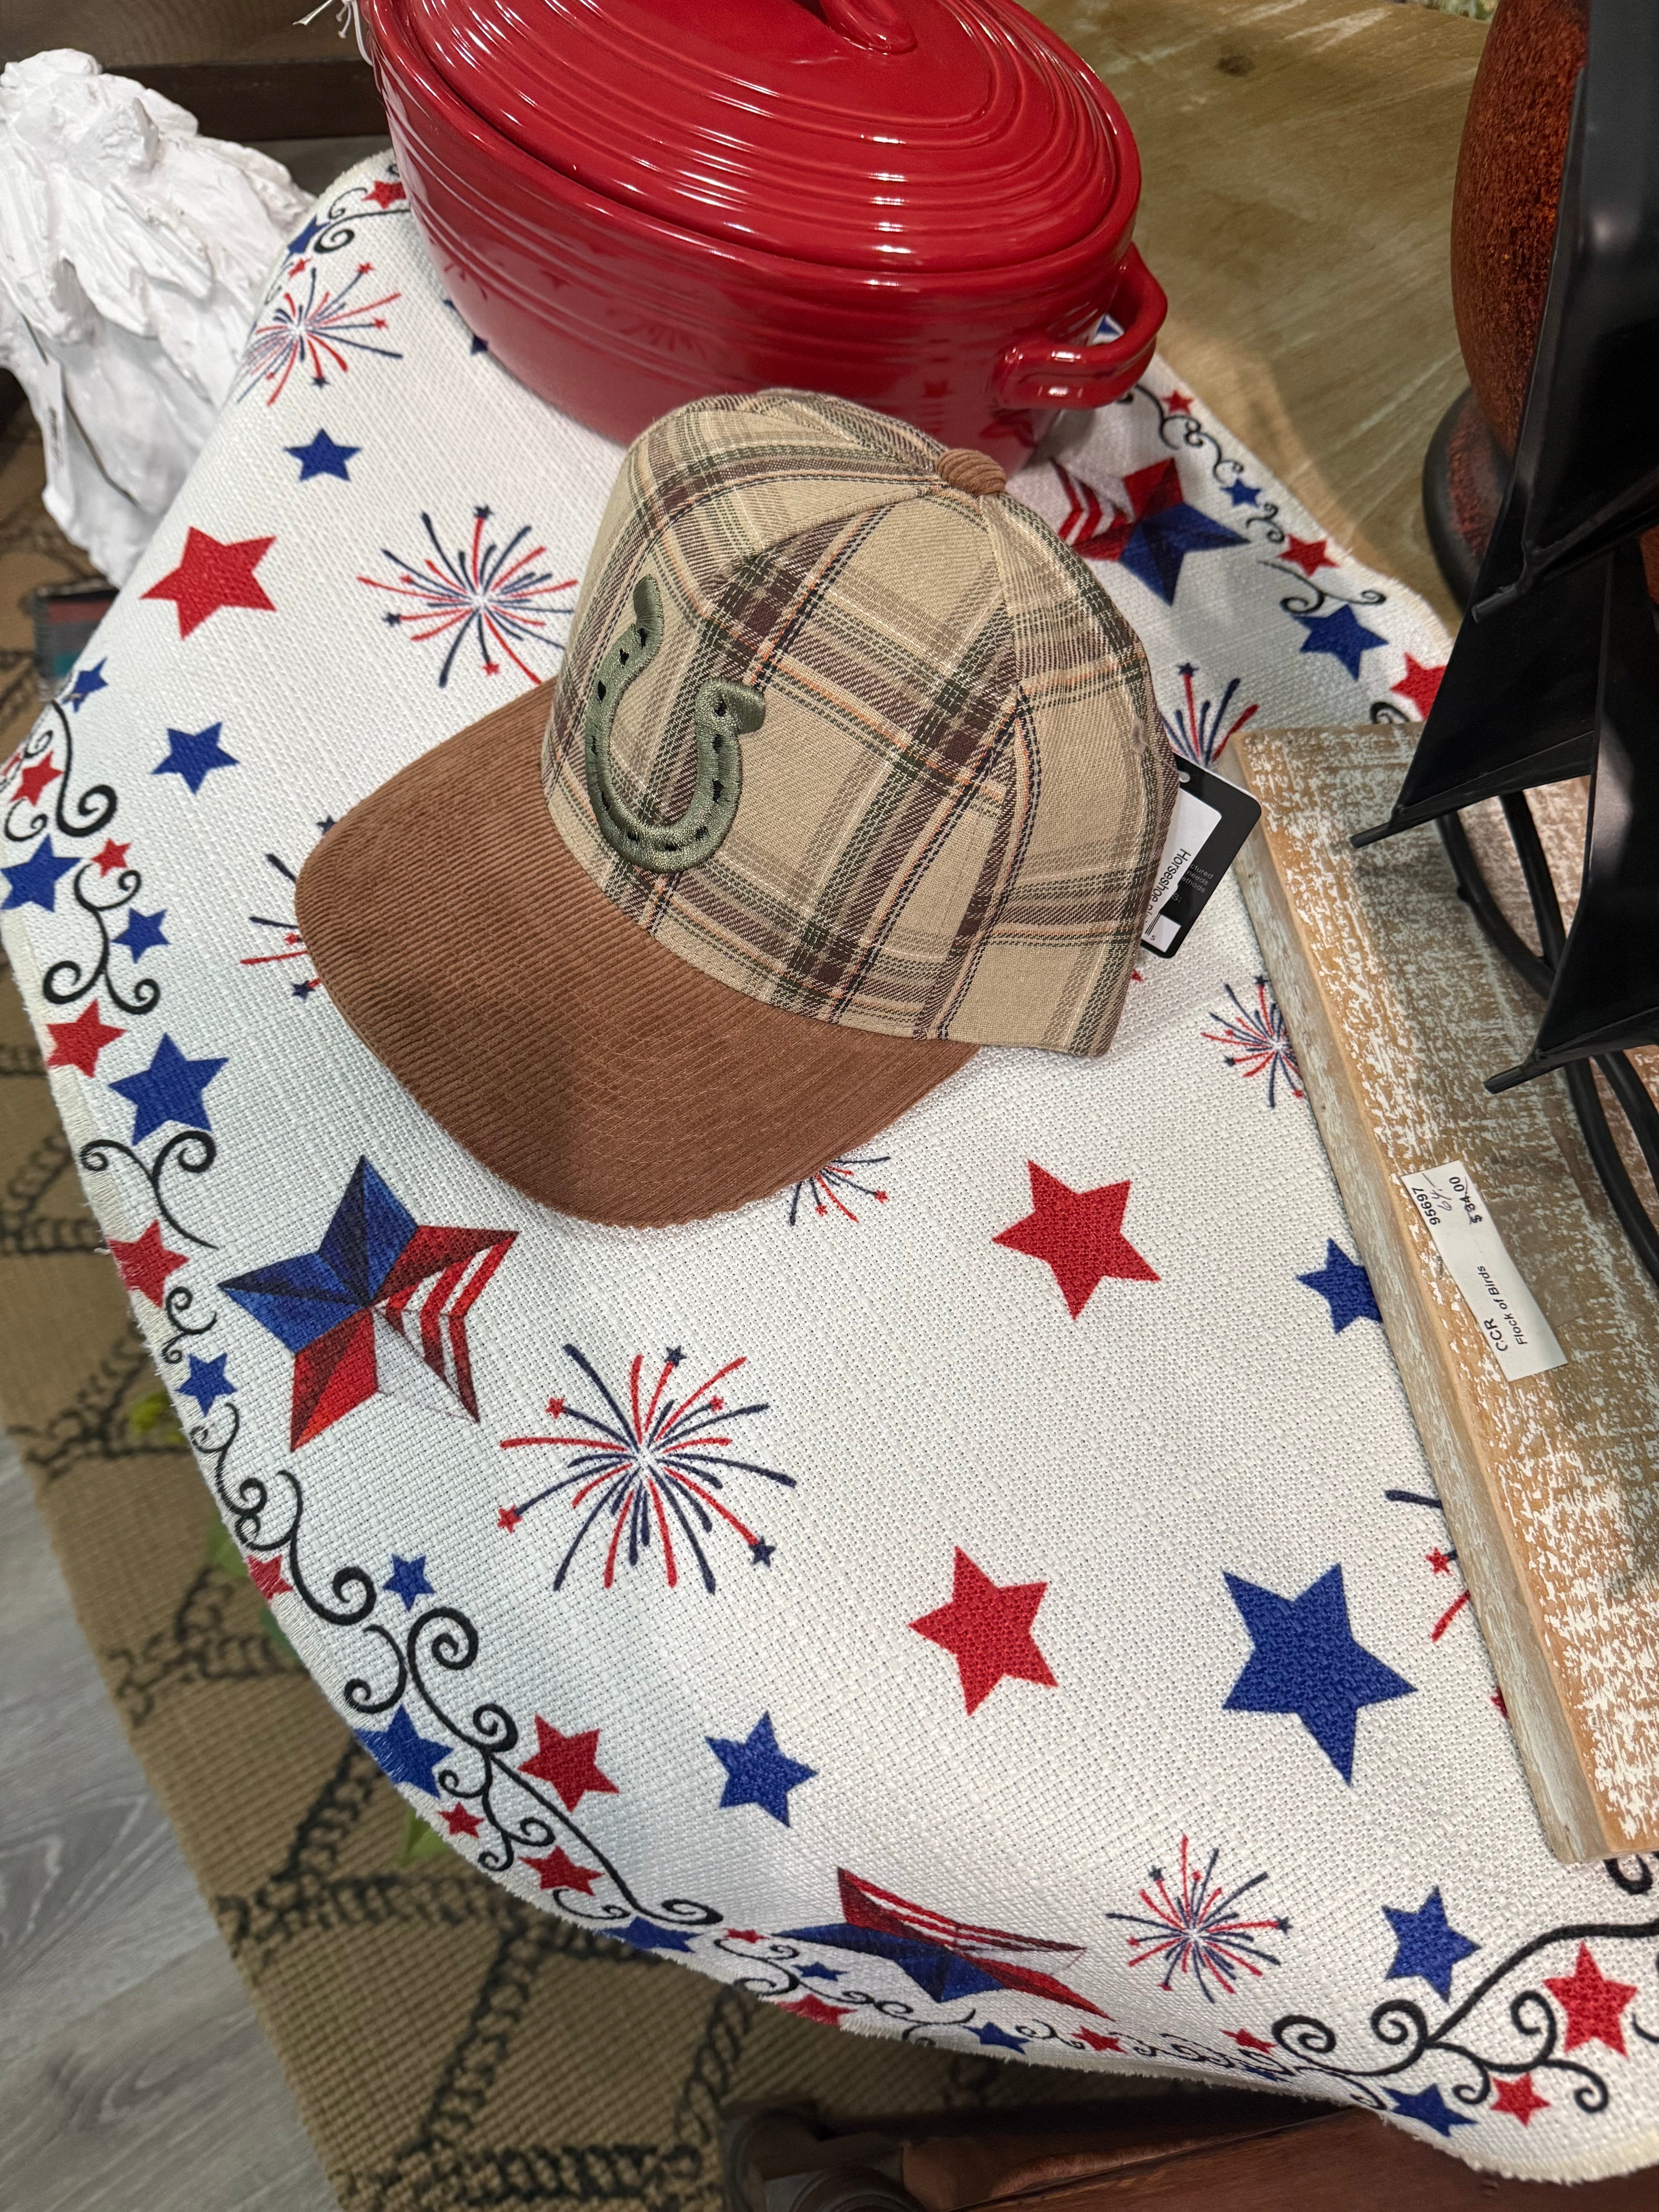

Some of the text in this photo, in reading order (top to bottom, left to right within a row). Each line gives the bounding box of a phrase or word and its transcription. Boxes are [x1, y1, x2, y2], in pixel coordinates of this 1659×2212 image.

[1151, 849, 1191, 902] Horseshoe
[1182, 876, 1205, 893] ethods
[1186, 871, 1208, 886] needs
[1190, 864, 1214, 879] ctured
[1411, 1187, 1441, 1225] 95697
[1477, 1265, 1528, 1345] Flock of Birds
[1484, 1318, 1508, 1351] CCR
